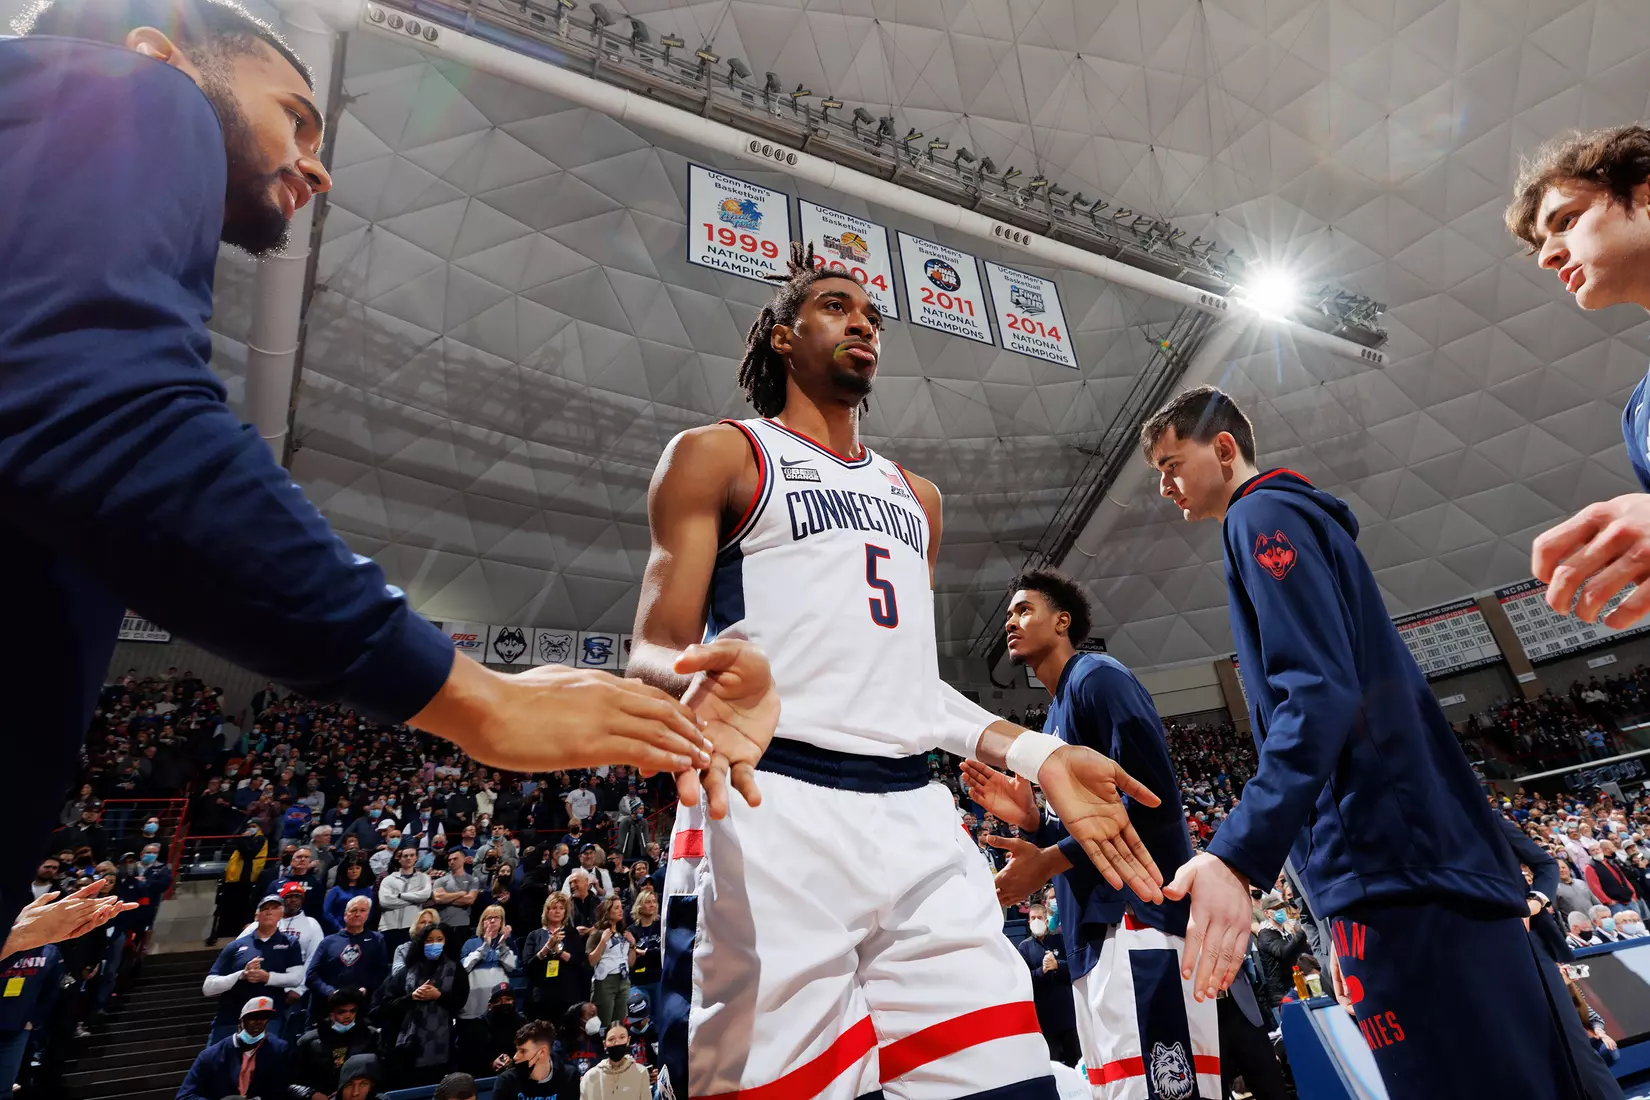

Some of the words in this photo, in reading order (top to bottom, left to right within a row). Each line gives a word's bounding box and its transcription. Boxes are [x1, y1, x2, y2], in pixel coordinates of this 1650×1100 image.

[708, 172, 741, 188] UConn
[743, 183, 771, 197] Men's
[714, 182, 765, 203] Basketball
[815, 206, 845, 221] UConn
[847, 216, 872, 230] Men's
[822, 216, 867, 235] Basketball
[703, 223, 779, 259] 1999
[823, 234, 841, 243] NCAA
[912, 237, 939, 251] UConn
[940, 246, 962, 259] Men's
[707, 245, 777, 271] NATIONAL
[918, 247, 960, 265] Basketball
[997, 266, 1022, 280] UConn
[1023, 273, 1044, 285] Men's
[1004, 275, 1041, 291] Basketball
[920, 287, 975, 317] 2011
[920, 316, 984, 340] CHAMPIONS
[923, 306, 978, 329] NATIONAL
[1006, 313, 1062, 342] 2014
[1010, 342, 1069, 364] CHAMPIONS
[1012, 332, 1063, 352] NATIONAL
[785, 489, 925, 560] CONNECTICUT
[864, 543, 899, 629] 5
[1502, 584, 1531, 596] NCAA
[1416, 610, 1440, 619] ATHLETIC
[1441, 600, 1474, 613] CONFERENCE
[1424, 609, 1469, 624] CHAMPIONS
[451, 633, 479, 641] BIG
[456, 640, 485, 648] AST
[1532, 646, 1579, 663] CONNECTICUT
[1580, 636, 1613, 649] WOMEN'S
[1429, 666, 1460, 678] WOMEN'S
[1461, 656, 1504, 669] BASKETBALL
